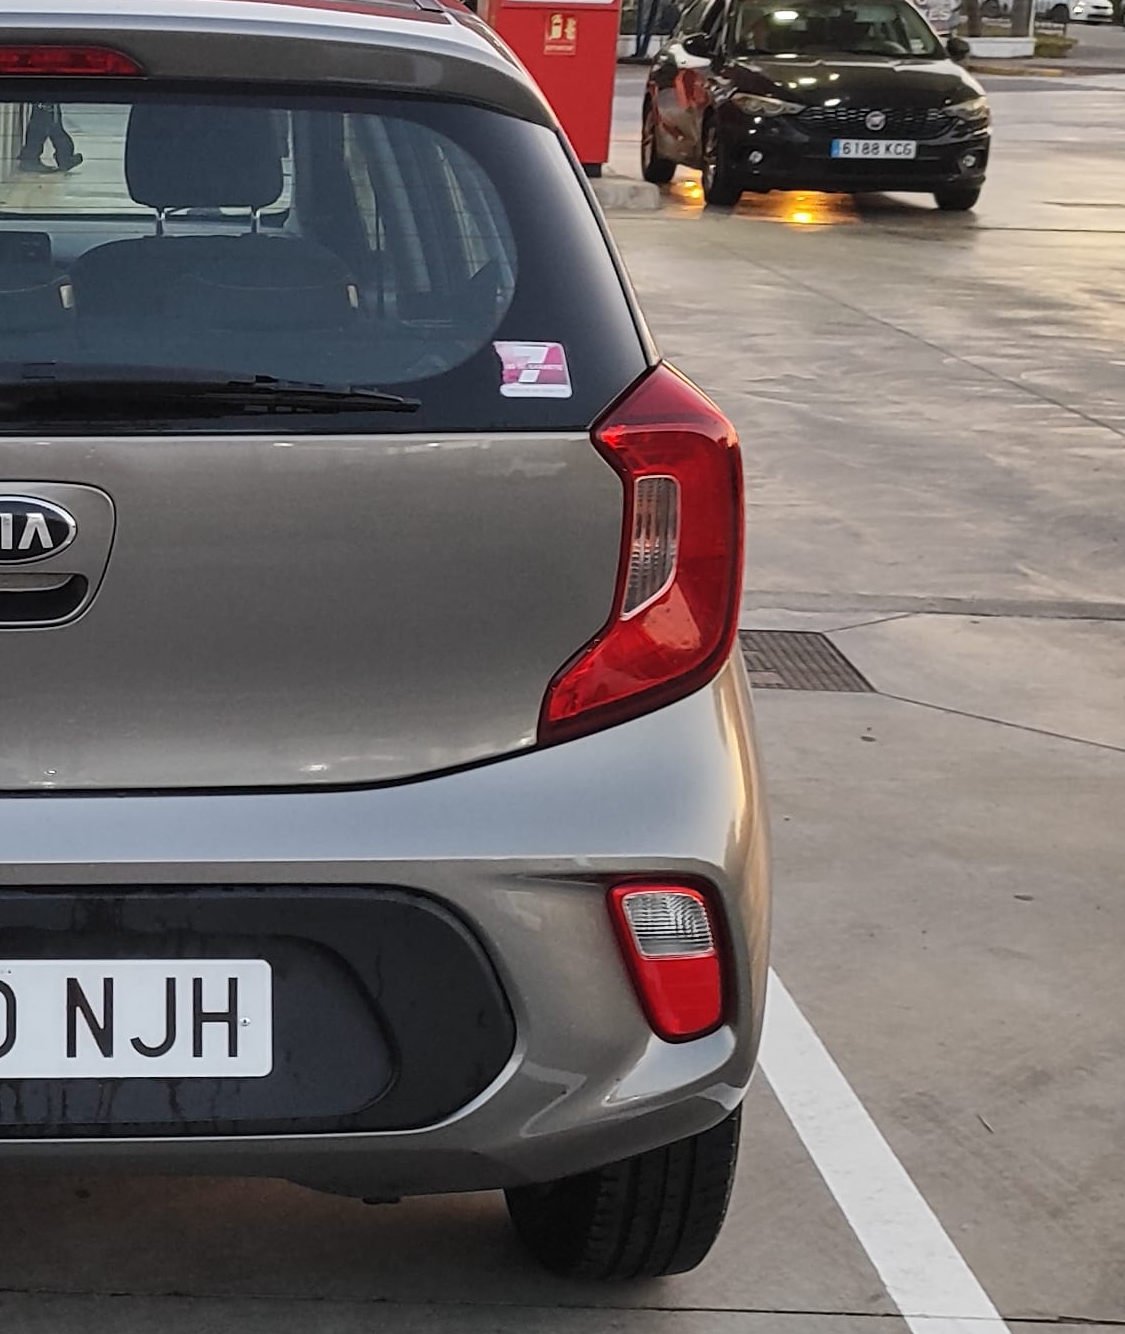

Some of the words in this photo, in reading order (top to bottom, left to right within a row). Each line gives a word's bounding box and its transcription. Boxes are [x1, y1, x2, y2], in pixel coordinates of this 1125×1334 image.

[842, 142, 880, 155] 6188
[884, 142, 912, 155] KCG
[66, 976, 239, 1059] NJH
